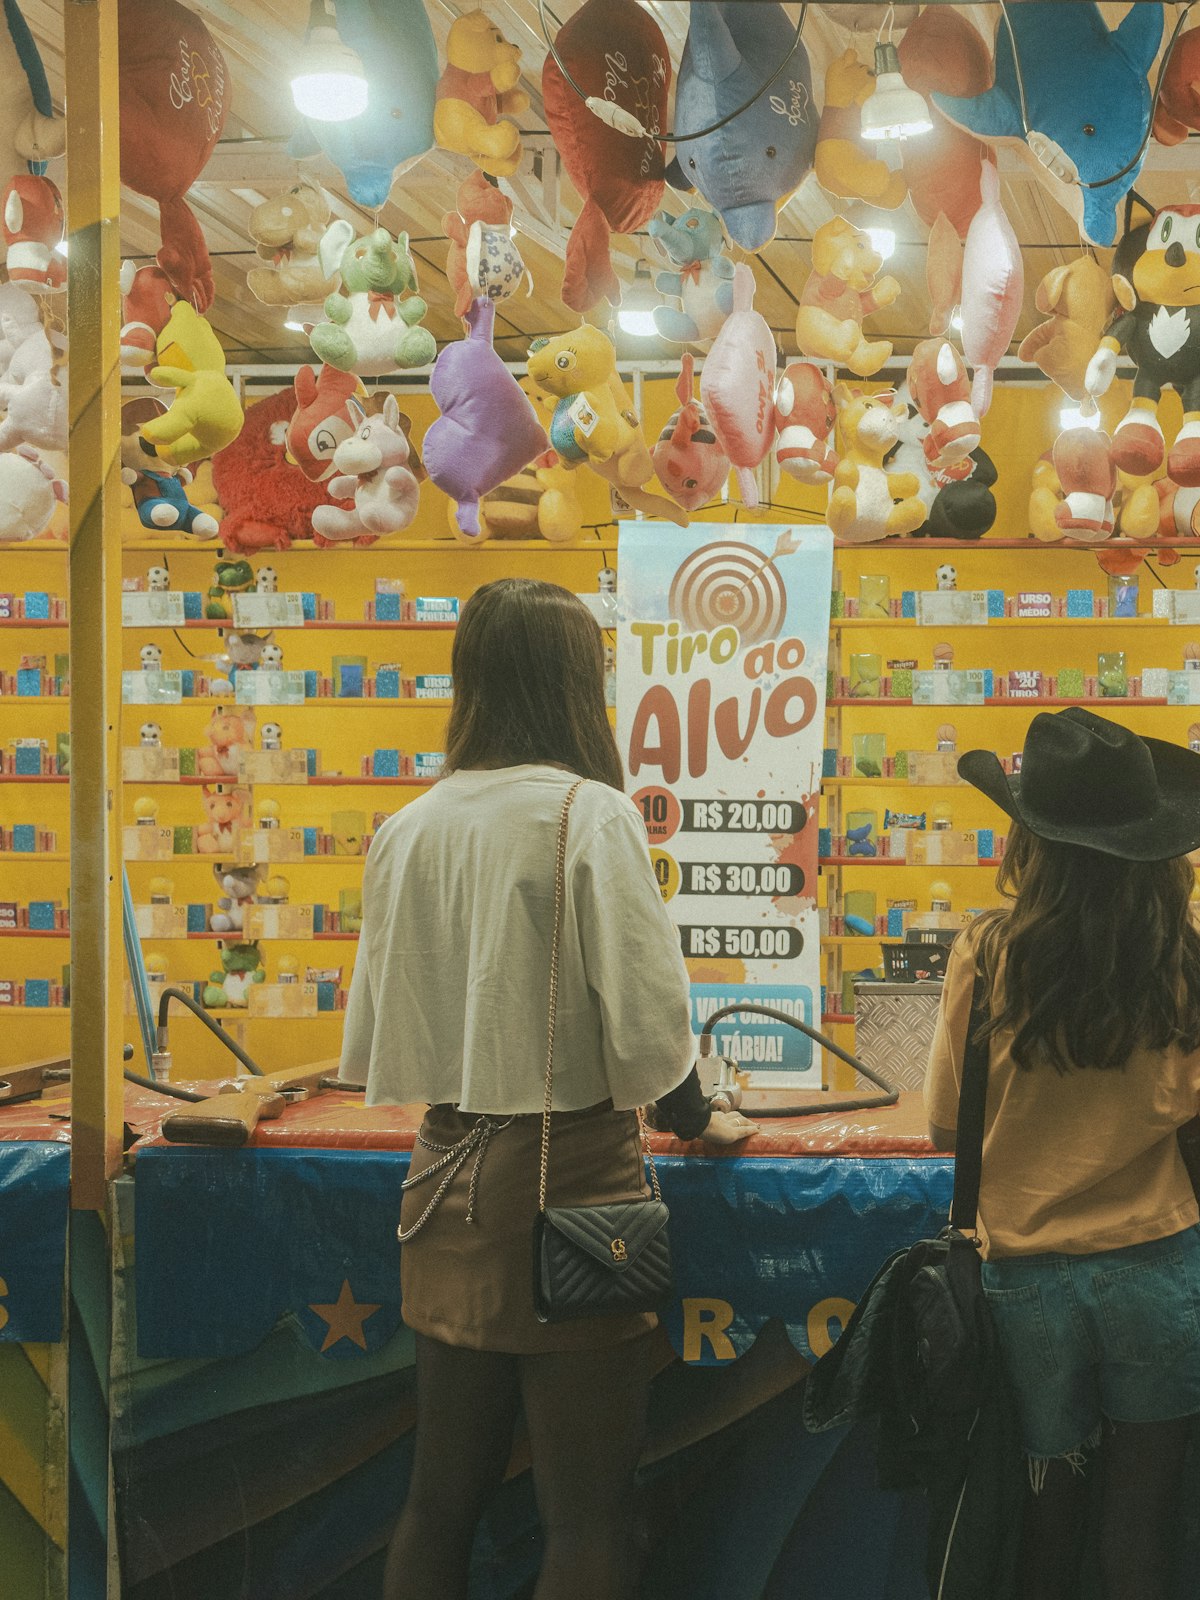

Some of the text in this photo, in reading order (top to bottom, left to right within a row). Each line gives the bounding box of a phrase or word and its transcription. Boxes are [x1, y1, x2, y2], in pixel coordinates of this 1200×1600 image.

[603, 50, 629, 101] Voc
[972, 593, 985, 601] 200
[1020, 593, 1052, 604] URSO
[1018, 606, 1051, 617] MÉDIO
[631, 622, 738, 676] Tiro
[743, 638, 806, 680] ao
[969, 672, 983, 680] 100
[1014, 670, 1041, 680] VALE
[1018, 679, 1038, 689] 20
[416, 688, 454, 698] PEQUEN
[1009, 689, 1039, 698] TIROS
[628, 676, 818, 785] Alvo
[640, 795, 668, 822] 10
[693, 801, 793, 831] R$ 20,00
[160, 829, 171, 837] 20
[290, 831, 301, 840] 20
[963, 833, 975, 842] 20
[652, 858, 670, 886] 0
[691, 864, 792, 894] R$ 30,00
[174, 907, 185, 916] 20
[300, 907, 311, 916] 20
[960, 914, 972, 923] 20
[690, 927, 791, 958] R$ 50,00
[303, 985, 314, 995] 20
[720, 1030, 784, 1063] TÁBUA!
